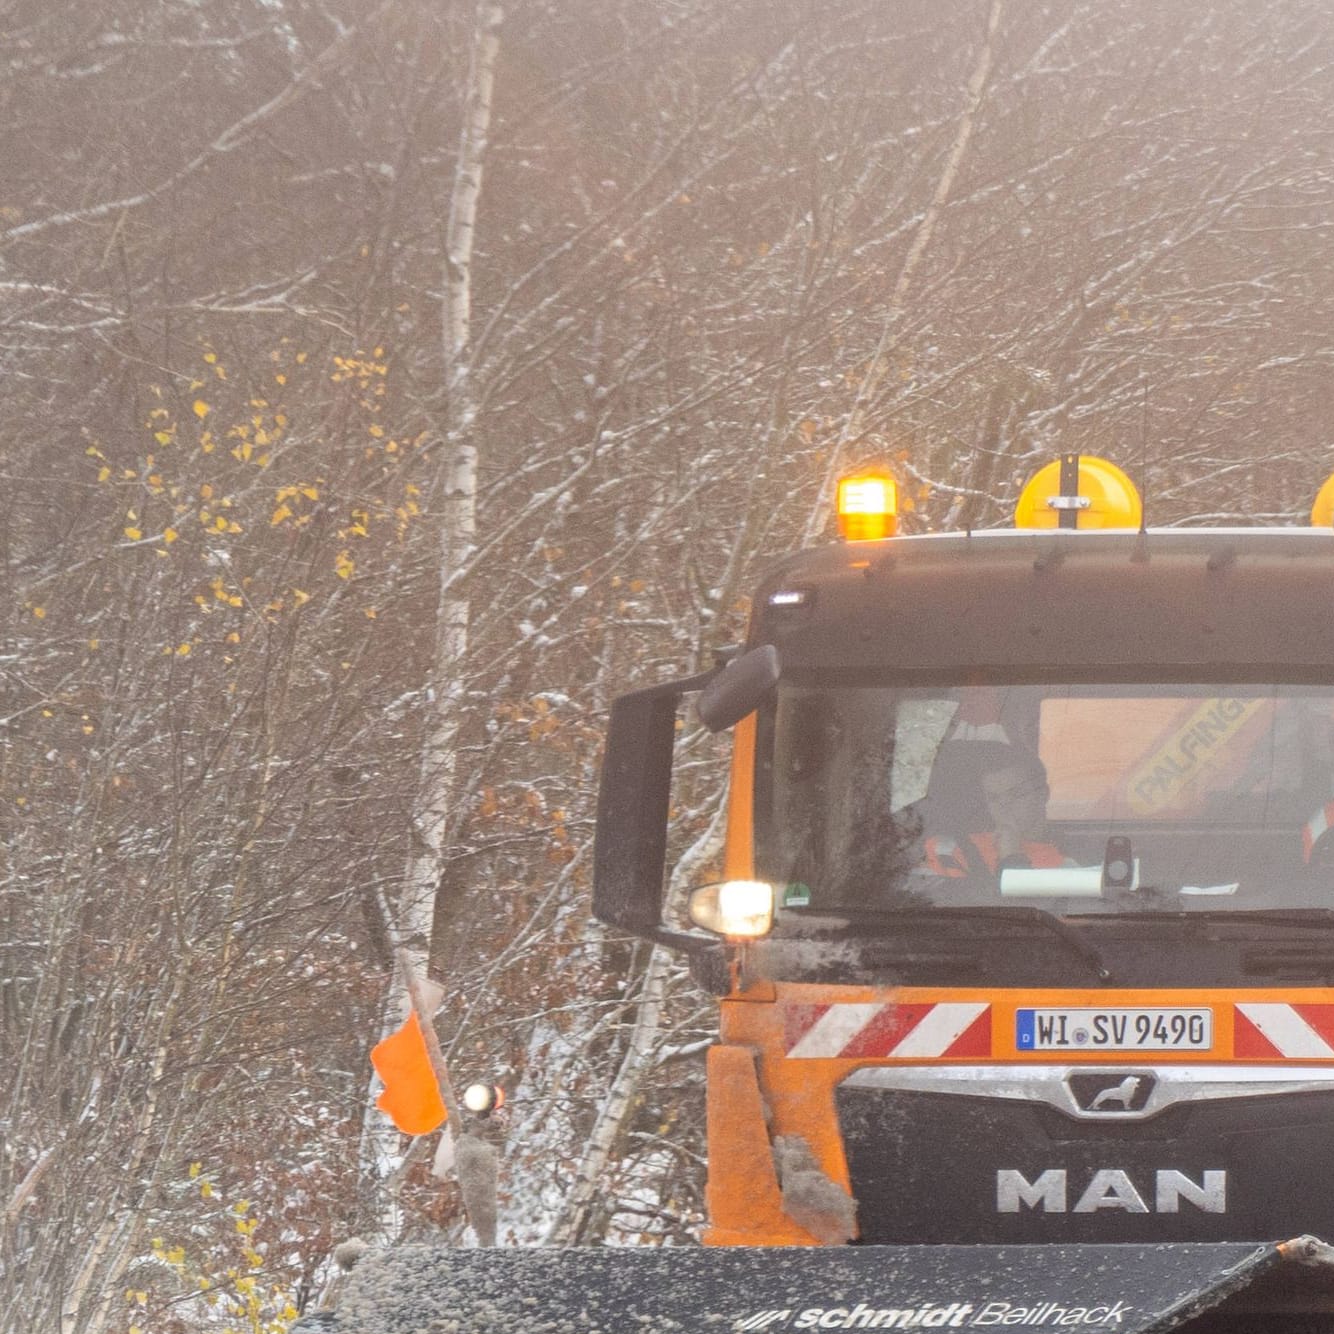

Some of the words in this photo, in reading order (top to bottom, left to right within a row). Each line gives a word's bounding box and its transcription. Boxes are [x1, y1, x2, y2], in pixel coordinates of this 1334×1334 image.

[1038, 1015, 1069, 1045] WI
[1093, 1015, 1127, 1045] SV
[1135, 1015, 1204, 1045] 9490
[997, 1169, 1227, 1213] MAN
[794, 1303, 976, 1330] schmidt
[973, 1301, 1134, 1326] Beilhack
